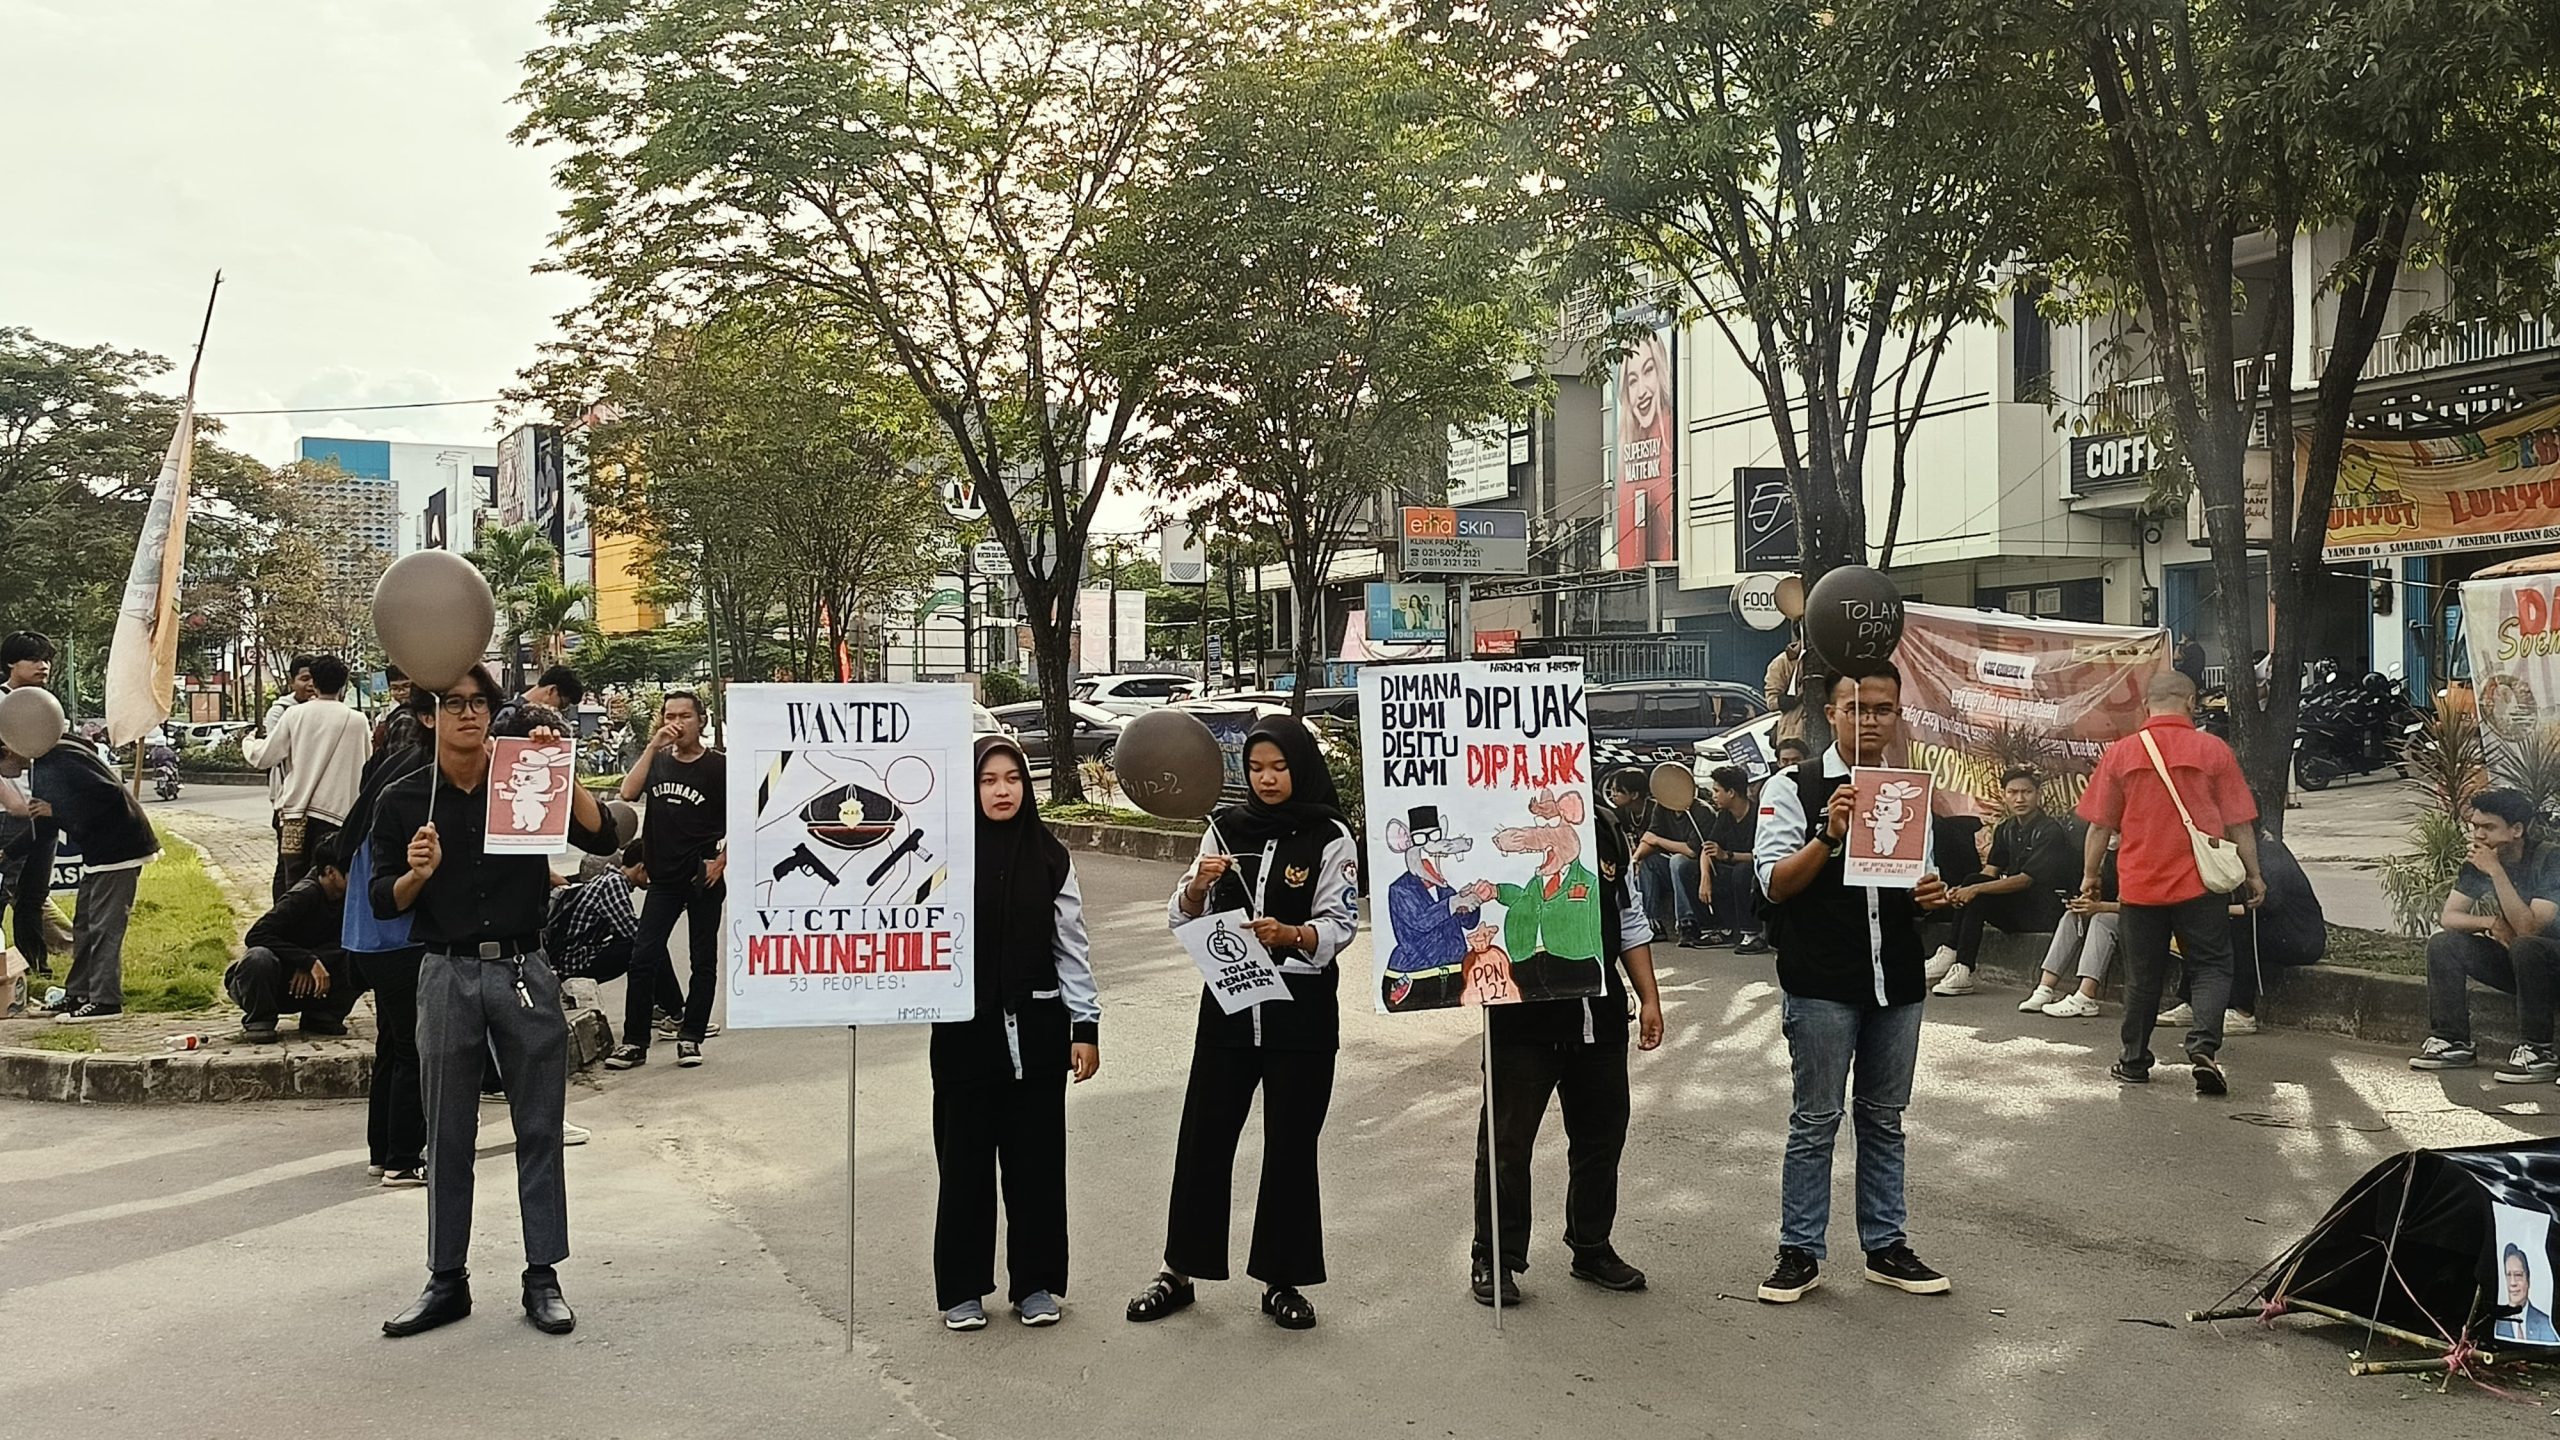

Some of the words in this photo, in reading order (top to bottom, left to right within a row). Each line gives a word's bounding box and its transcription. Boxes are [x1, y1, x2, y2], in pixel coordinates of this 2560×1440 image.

[1623, 436, 1662, 462] SUPERSTAY
[2086, 432, 2165, 479] COFFE
[1624, 459, 1648, 482] MATTE
[1647, 457, 1661, 479] INK
[2327, 502, 2416, 530] UNYUT
[1410, 538, 1434, 546] KLINIK
[1422, 548, 1461, 557] 021-5092
[1463, 549, 1480, 557] 2121
[2327, 548, 2356, 558] YAMIN
[2373, 545, 2380, 554] 6
[2390, 539, 2442, 553] SAMARINDA
[2457, 535, 2501, 548] MENERIMA
[2504, 529, 2541, 543] PESANAN
[1422, 558, 1441, 566] 0811
[1443, 558, 1461, 567] 2121
[1463, 558, 1480, 567] 2121
[1839, 600, 1899, 621] TOLAK
[2515, 587, 2560, 637] D
[1394, 631, 1414, 639] TOKO
[1416, 631, 1446, 639] APOLLO
[1858, 621, 1892, 639] PPN
[1381, 673, 1462, 701] DIMANA
[787, 702, 910, 743] WANTED
[1381, 701, 1446, 730] BUMI
[1465, 684, 1586, 738] DIPIJAK
[1901, 704, 1922, 728] Depa
[1383, 731, 1458, 758] DISITU
[1384, 758, 1447, 787] KAMI
[1467, 742, 1586, 791] DIPAJAK
[1215, 967, 1274, 990] KENAIKAN
[1220, 960, 1261, 977] TOLAK
[1472, 963, 1504, 987] PPN
[789, 977, 808, 992] 53
[823, 975, 906, 991] PEOPLES!
[1227, 980, 1253, 996] PPN
[1254, 977, 1274, 989] 12%
[1479, 982, 1508, 1003] 12%
[898, 1007, 941, 1020] HMPKN
